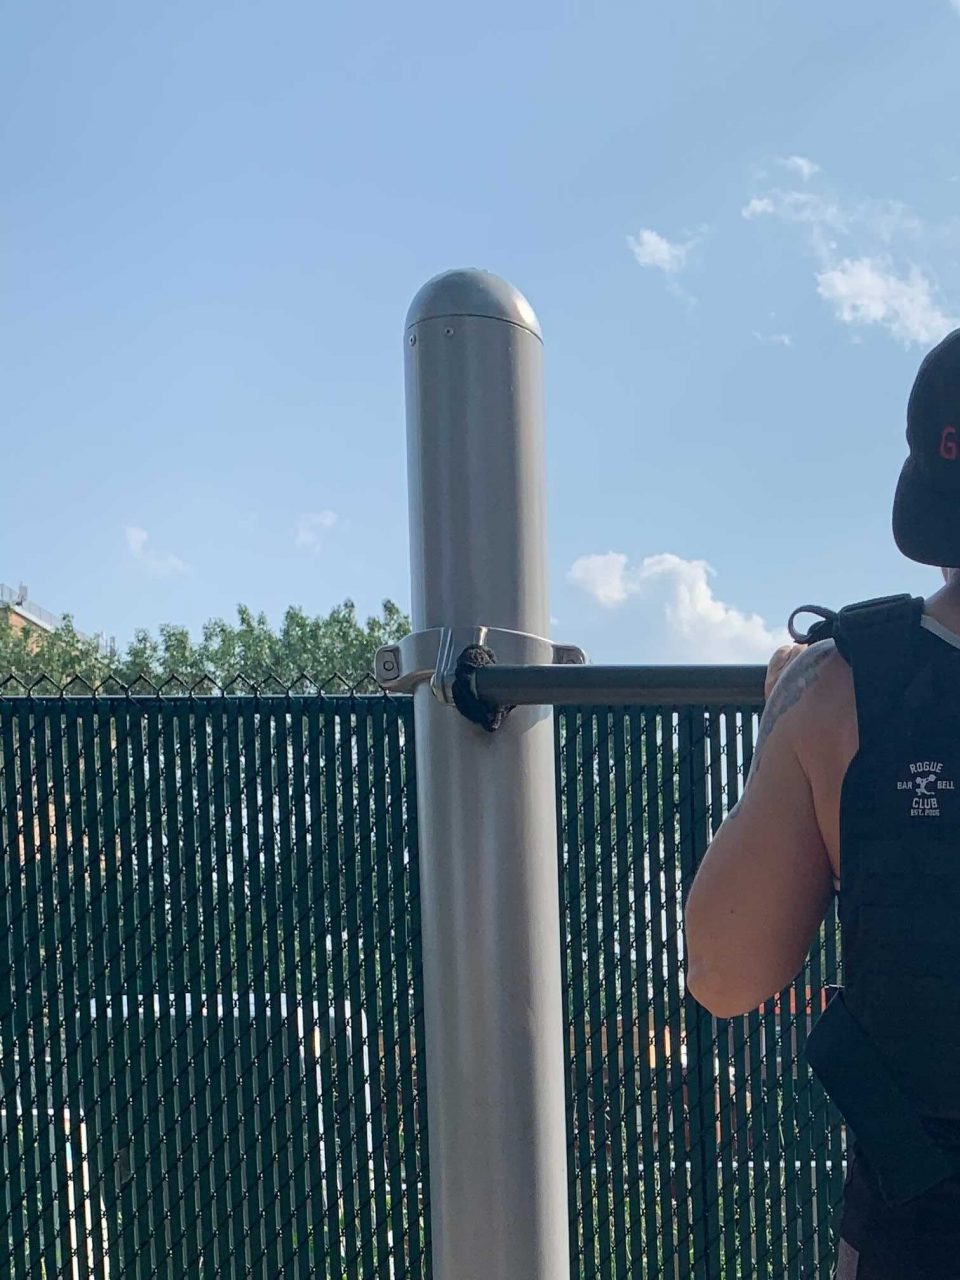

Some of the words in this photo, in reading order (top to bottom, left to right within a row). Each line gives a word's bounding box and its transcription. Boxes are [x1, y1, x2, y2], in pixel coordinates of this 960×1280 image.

[909, 761, 944, 774] ROGUE
[897, 781, 913, 790] BAR
[937, 780, 955, 790] BELL
[912, 797, 938, 809] CLUB
